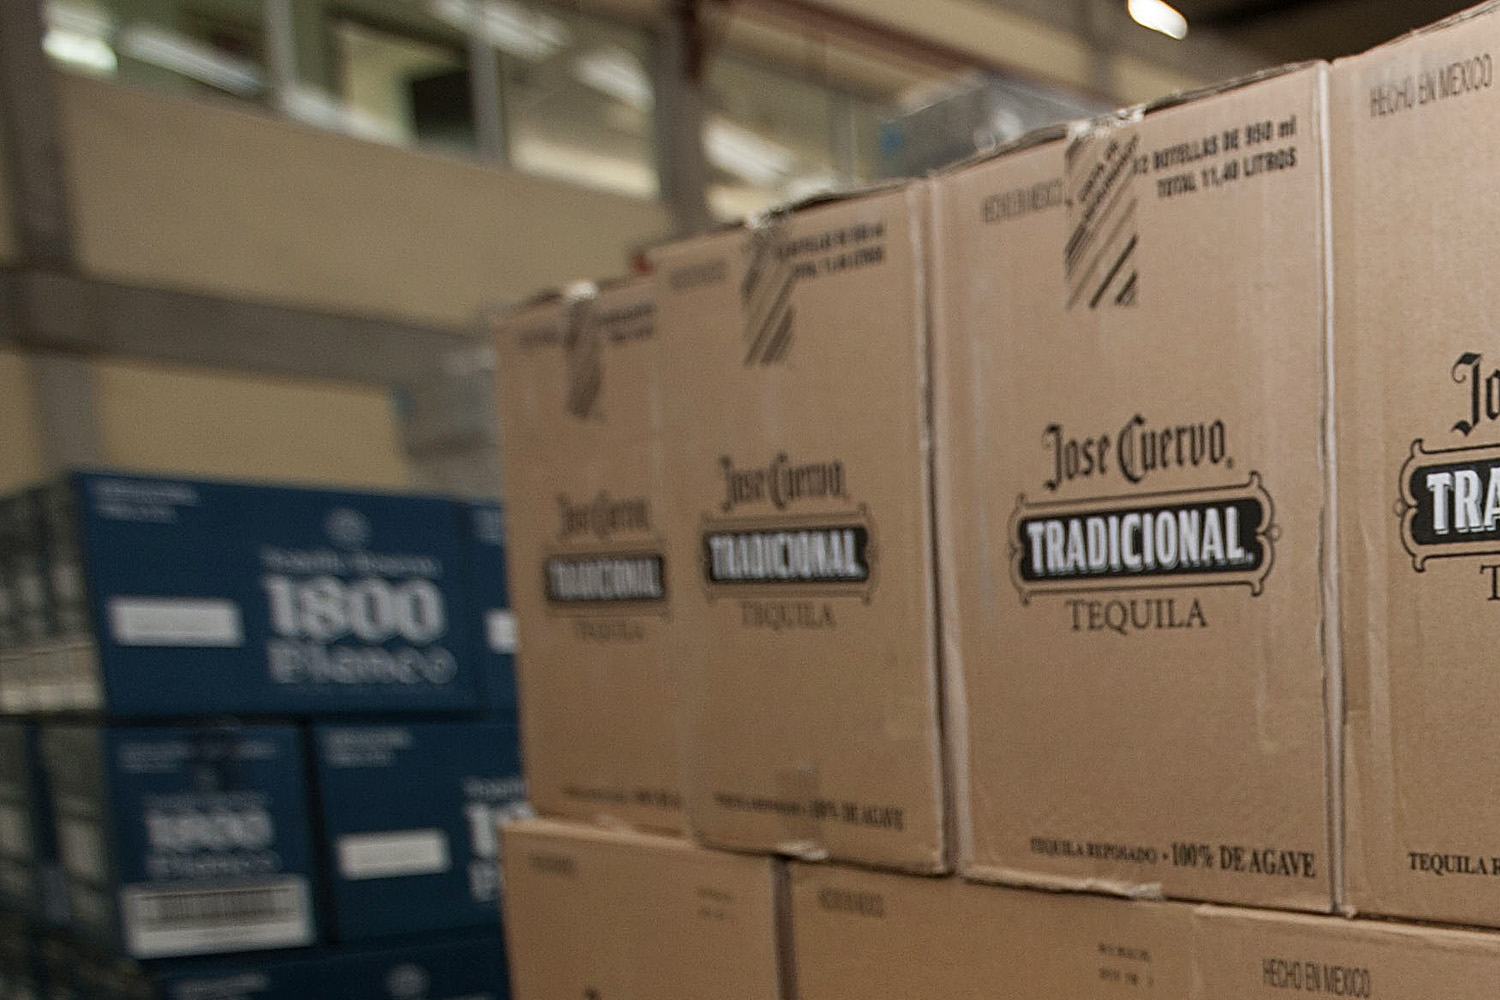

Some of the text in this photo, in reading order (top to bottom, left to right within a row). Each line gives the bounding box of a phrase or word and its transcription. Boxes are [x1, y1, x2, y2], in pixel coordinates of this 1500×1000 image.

[1041, 412, 1227, 491] Jose Cuervo
[1025, 505, 1247, 578] TRADICIONAL
[1065, 597, 1208, 635] TEQUILA
[1219, 844, 1247, 872] DE
[1248, 848, 1317, 878] AGAVE
[1407, 851, 1488, 876] TEQUILA
[1262, 957, 1301, 991] HECHO
